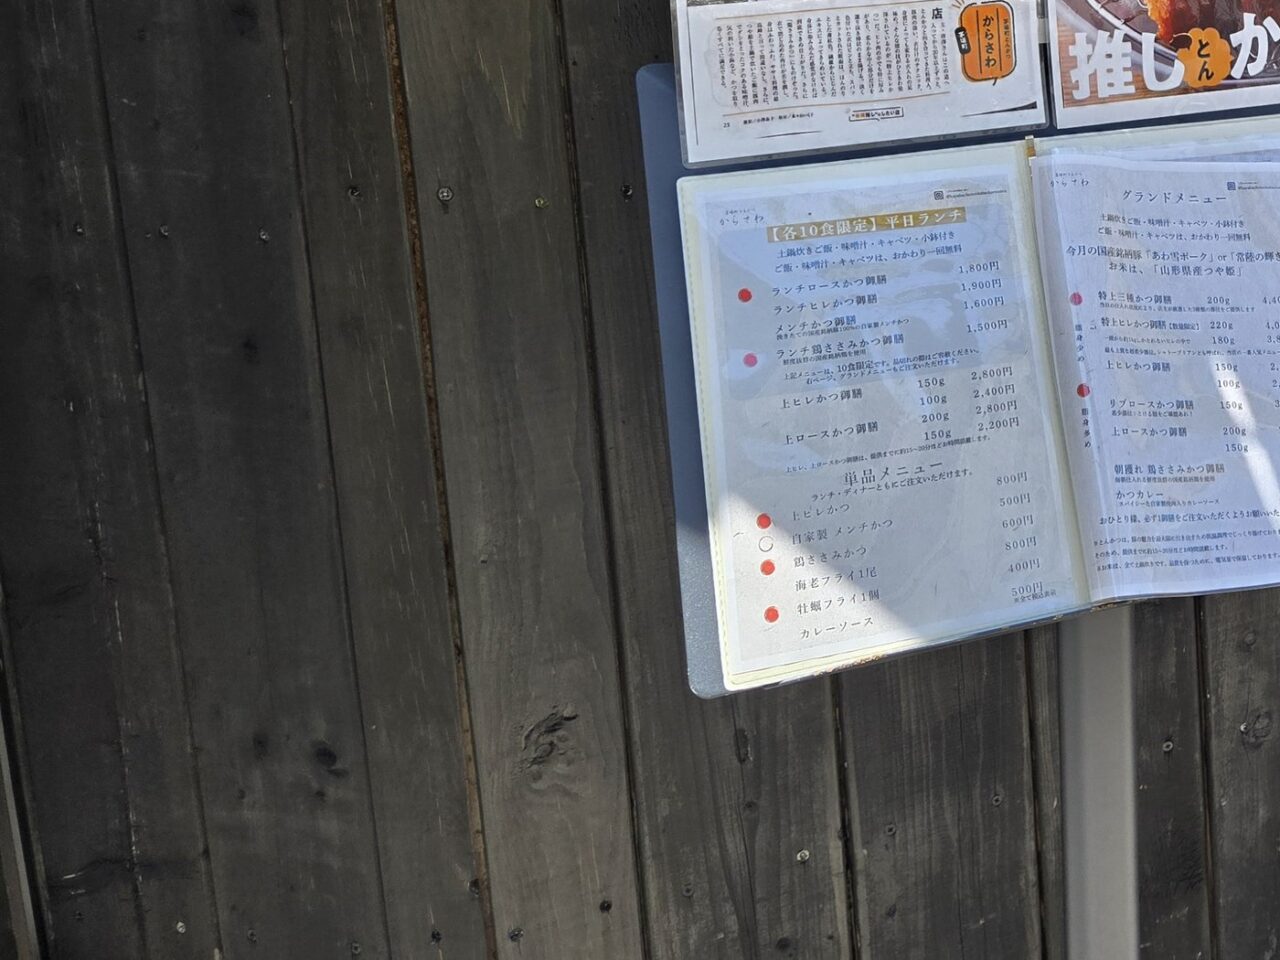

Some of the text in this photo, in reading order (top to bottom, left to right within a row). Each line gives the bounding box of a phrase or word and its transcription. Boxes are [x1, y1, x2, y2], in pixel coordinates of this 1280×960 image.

[931, 7, 943, 20] 店
[982, 15, 997, 68] からさわ
[1069, 29, 1185, 100] 推し
[1196, 38, 1214, 81] とん
[1122, 189, 1227, 204] グランドメニュー
[771, 260, 1000, 296] ランチロースかつ御膳 1,800円
[773, 278, 1002, 315] ランチヒレかつ御膳 1,900円
[1098, 290, 1172, 305] 特上三種かつ御膳
[1206, 296, 1231, 306] 200g
[775, 295, 1004, 334] メンチかつ御膳 1,600円
[1210, 321, 1234, 330] 220g
[775, 319, 1008, 359] ランチ鶏ささみかつ御膳 1,500円
[1212, 336, 1236, 345] 180g
[1106, 360, 1171, 372] 上ヒレかつ御膳
[1215, 363, 1239, 373] 150g
[781, 366, 1014, 409] 上ヒレかつ御膳 150g 2,800円
[919, 383, 1016, 406] 100g 2,400円
[1217, 379, 1241, 389] 100g
[1109, 399, 1195, 411] リブロースかつ御膳
[1219, 400, 1243, 410] 150g
[784, 400, 1018, 445] 上ロースかつ御膳 200g 2,800円
[924, 416, 1020, 441] 150g 2,200円
[1111, 426, 1188, 437] 上ロースかつ御膳
[1222, 427, 1247, 437] 200g
[1225, 443, 1249, 453] 150g
[843, 461, 943, 487] 単品メニュー
[792, 471, 1028, 521] 上ヒレかつ 800円
[999, 492, 1031, 507] 500円
[1116, 490, 1164, 500] かつカレー
[793, 514, 1034, 568] 鶏ささみかつ 600円
[795, 536, 1037, 592] 海老フライ1尾 800円
[796, 588, 880, 615] 牡蠣フライ1個
[800, 581, 1043, 639] カレーソース 500円
